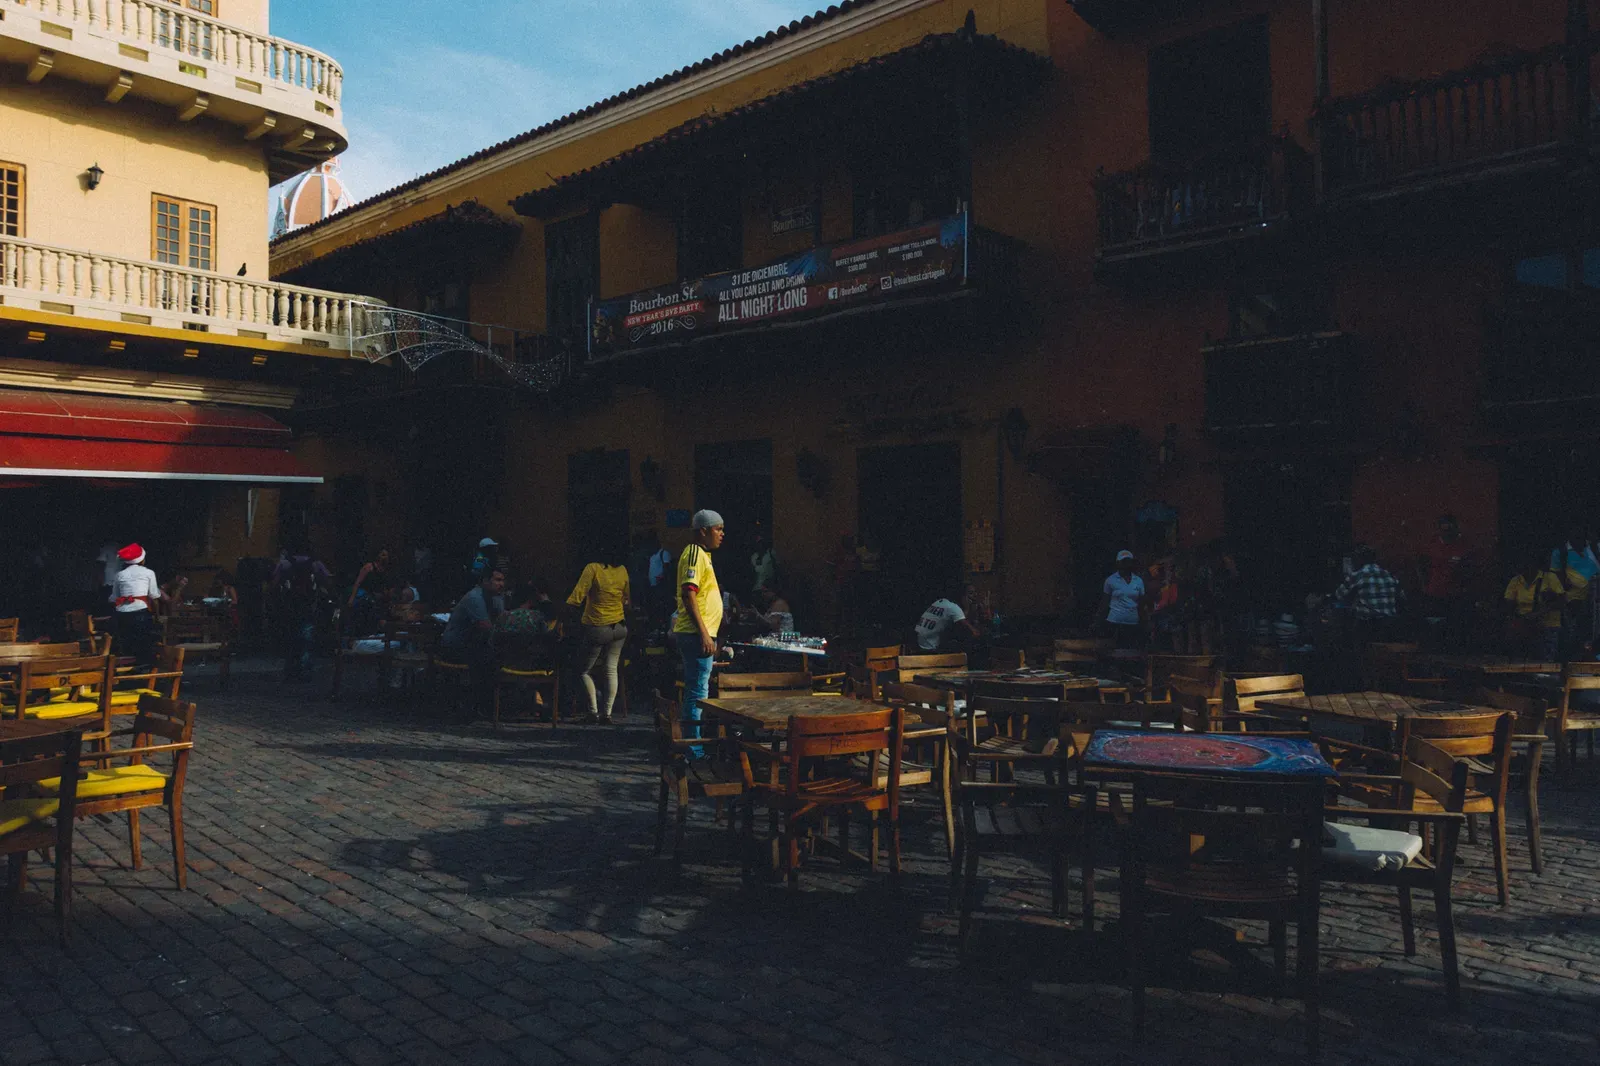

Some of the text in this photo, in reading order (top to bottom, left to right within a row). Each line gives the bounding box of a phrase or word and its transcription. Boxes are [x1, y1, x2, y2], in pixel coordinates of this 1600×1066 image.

[731, 262, 788, 286] 31 DE DICIEMBRE
[629, 285, 698, 314] Bourbon St.
[719, 273, 806, 302] ALL YOU CAN EAT AND DRINK
[627, 302, 700, 326] NEW YEAR'S EVE PARTY
[718, 287, 808, 322] ALL NIGHT LONG
[650, 319, 674, 335] 2016
